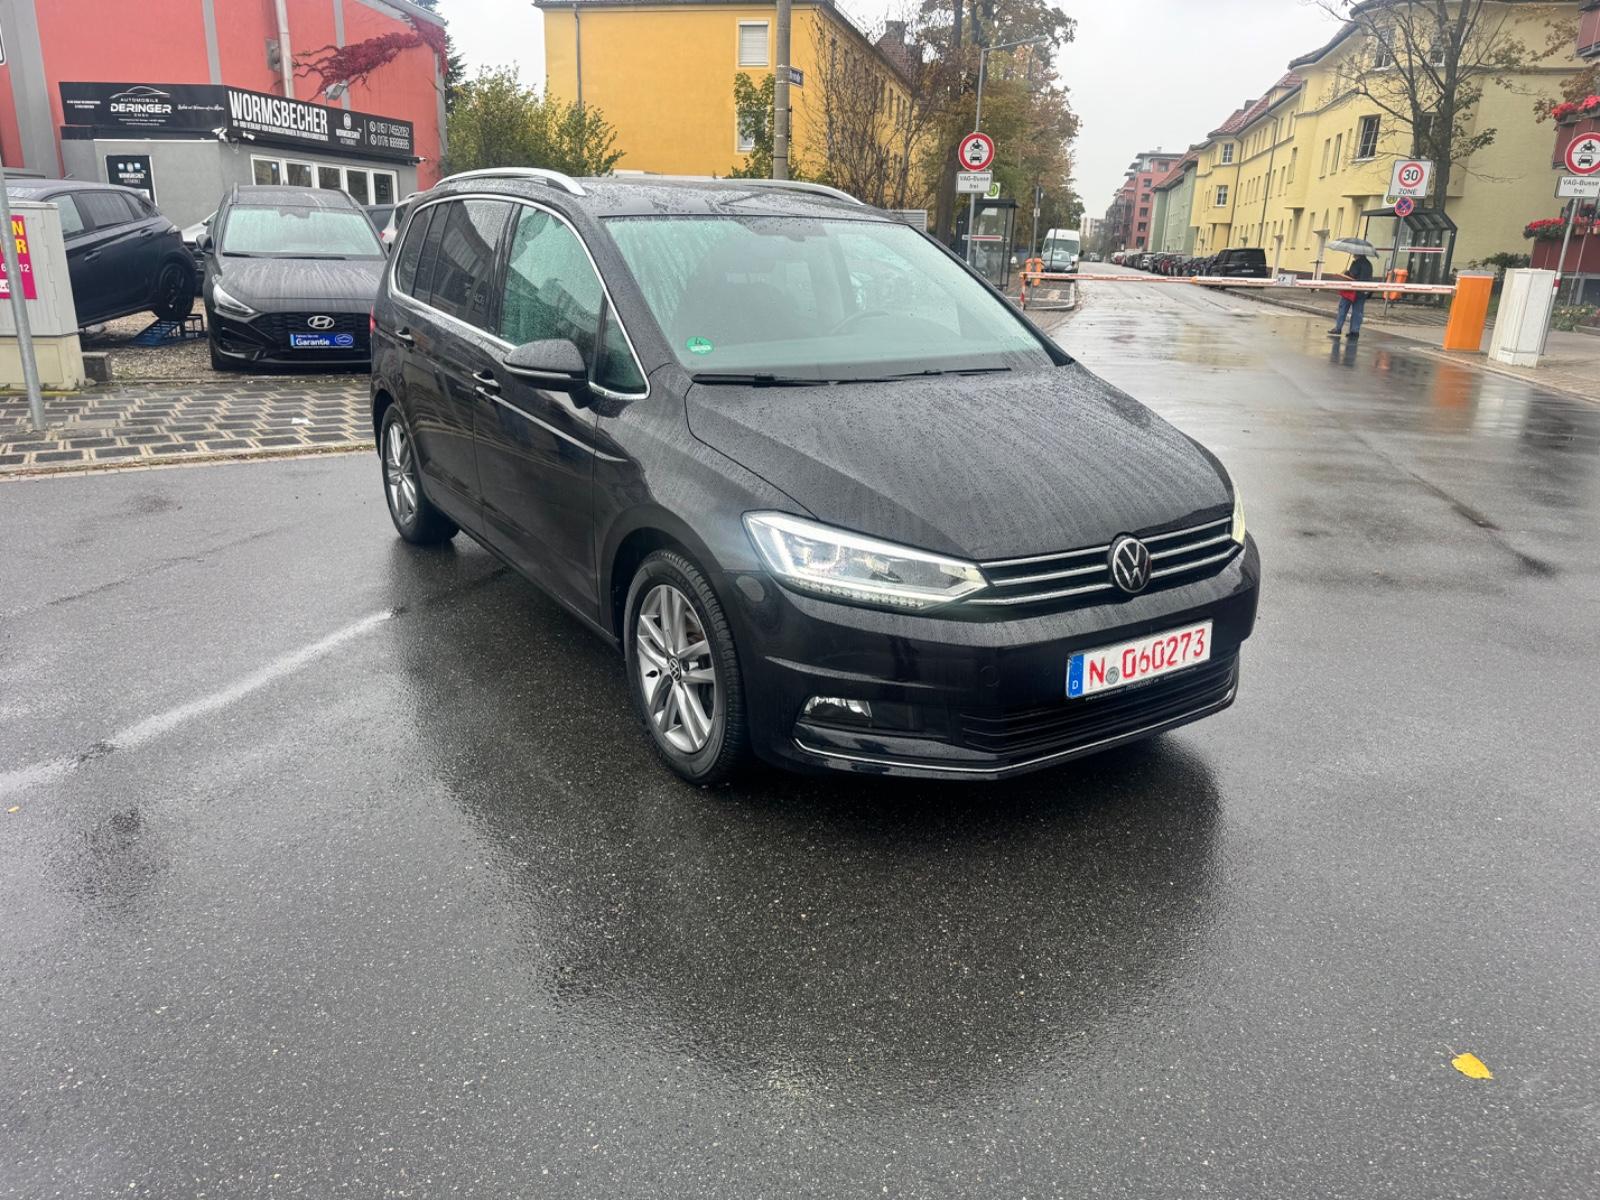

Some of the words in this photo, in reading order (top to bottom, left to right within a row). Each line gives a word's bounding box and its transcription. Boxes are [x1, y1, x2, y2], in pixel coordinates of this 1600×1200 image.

[110, 103, 172, 114] DERINGER
[228, 90, 328, 134] WORMSBECHER
[1403, 169, 1419, 181] 30
[1398, 188, 1418, 196] ZONE
[1089, 655, 1105, 688] N
[1072, 680, 1079, 690] D
